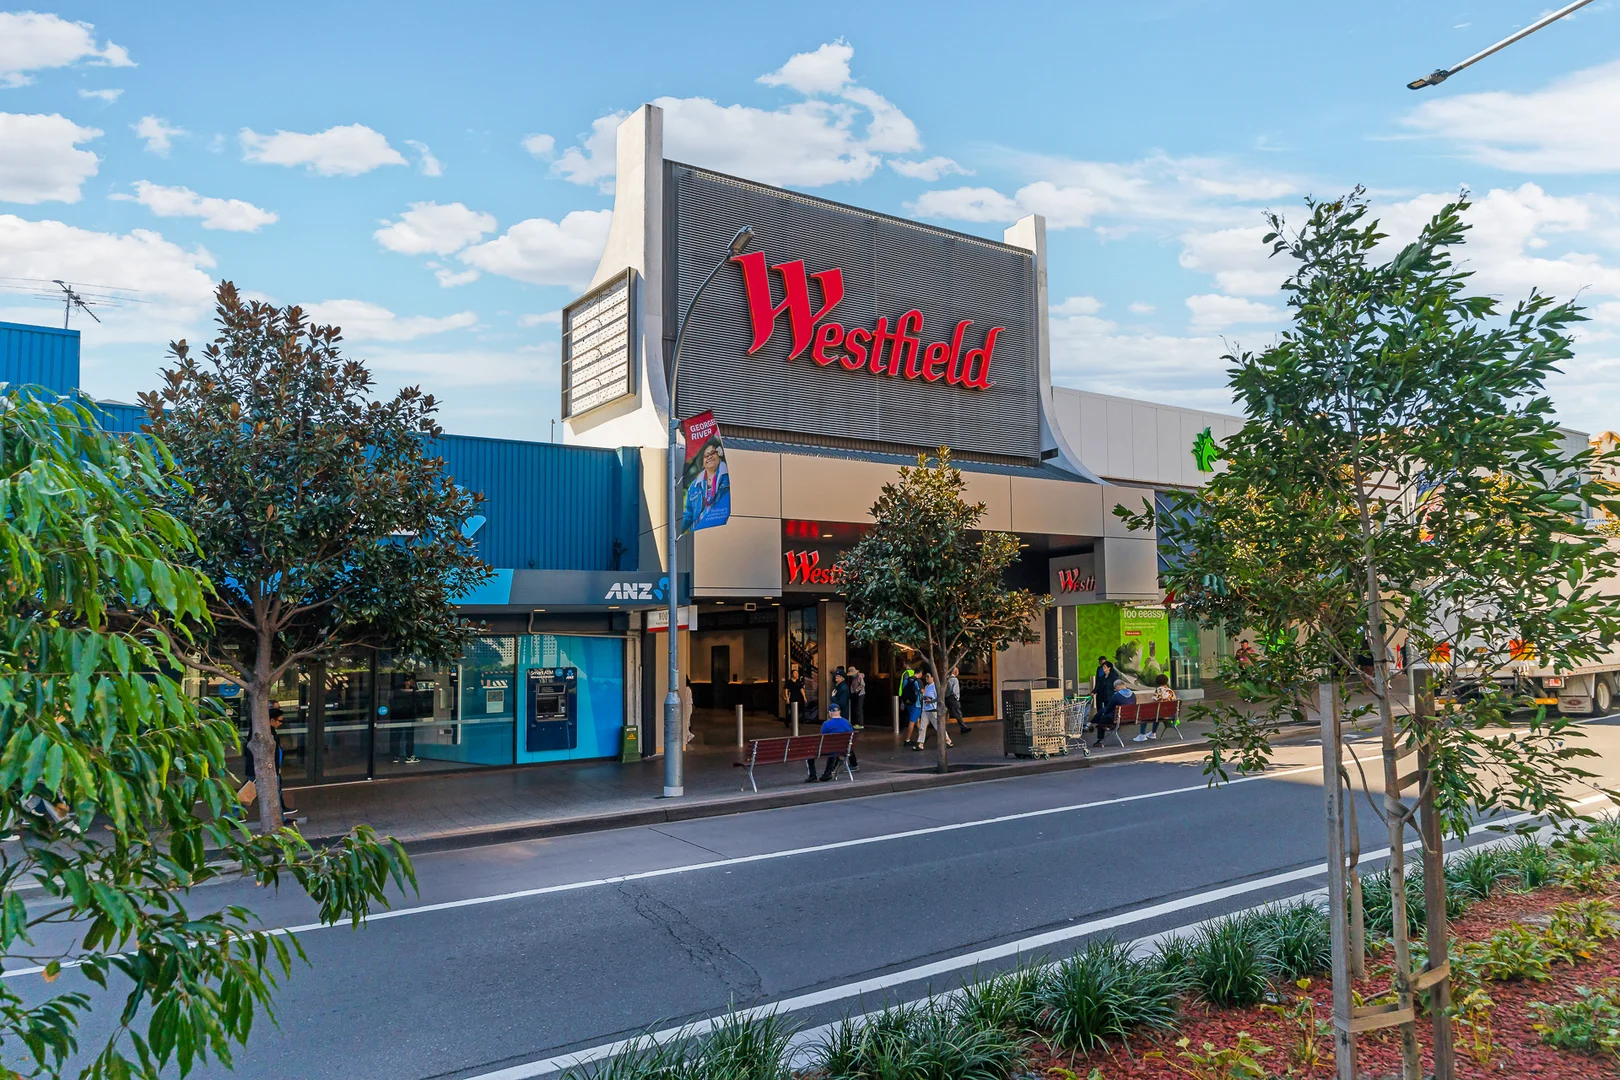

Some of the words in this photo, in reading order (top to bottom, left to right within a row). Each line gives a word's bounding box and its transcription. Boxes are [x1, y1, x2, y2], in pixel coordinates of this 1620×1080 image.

[730, 250, 1006, 392] Westfield
[689, 418, 716, 433] GEORGE
[691, 428, 712, 441] RIVER
[604, 582, 653, 600] ANZ
[1122, 608, 1137, 619] Too
